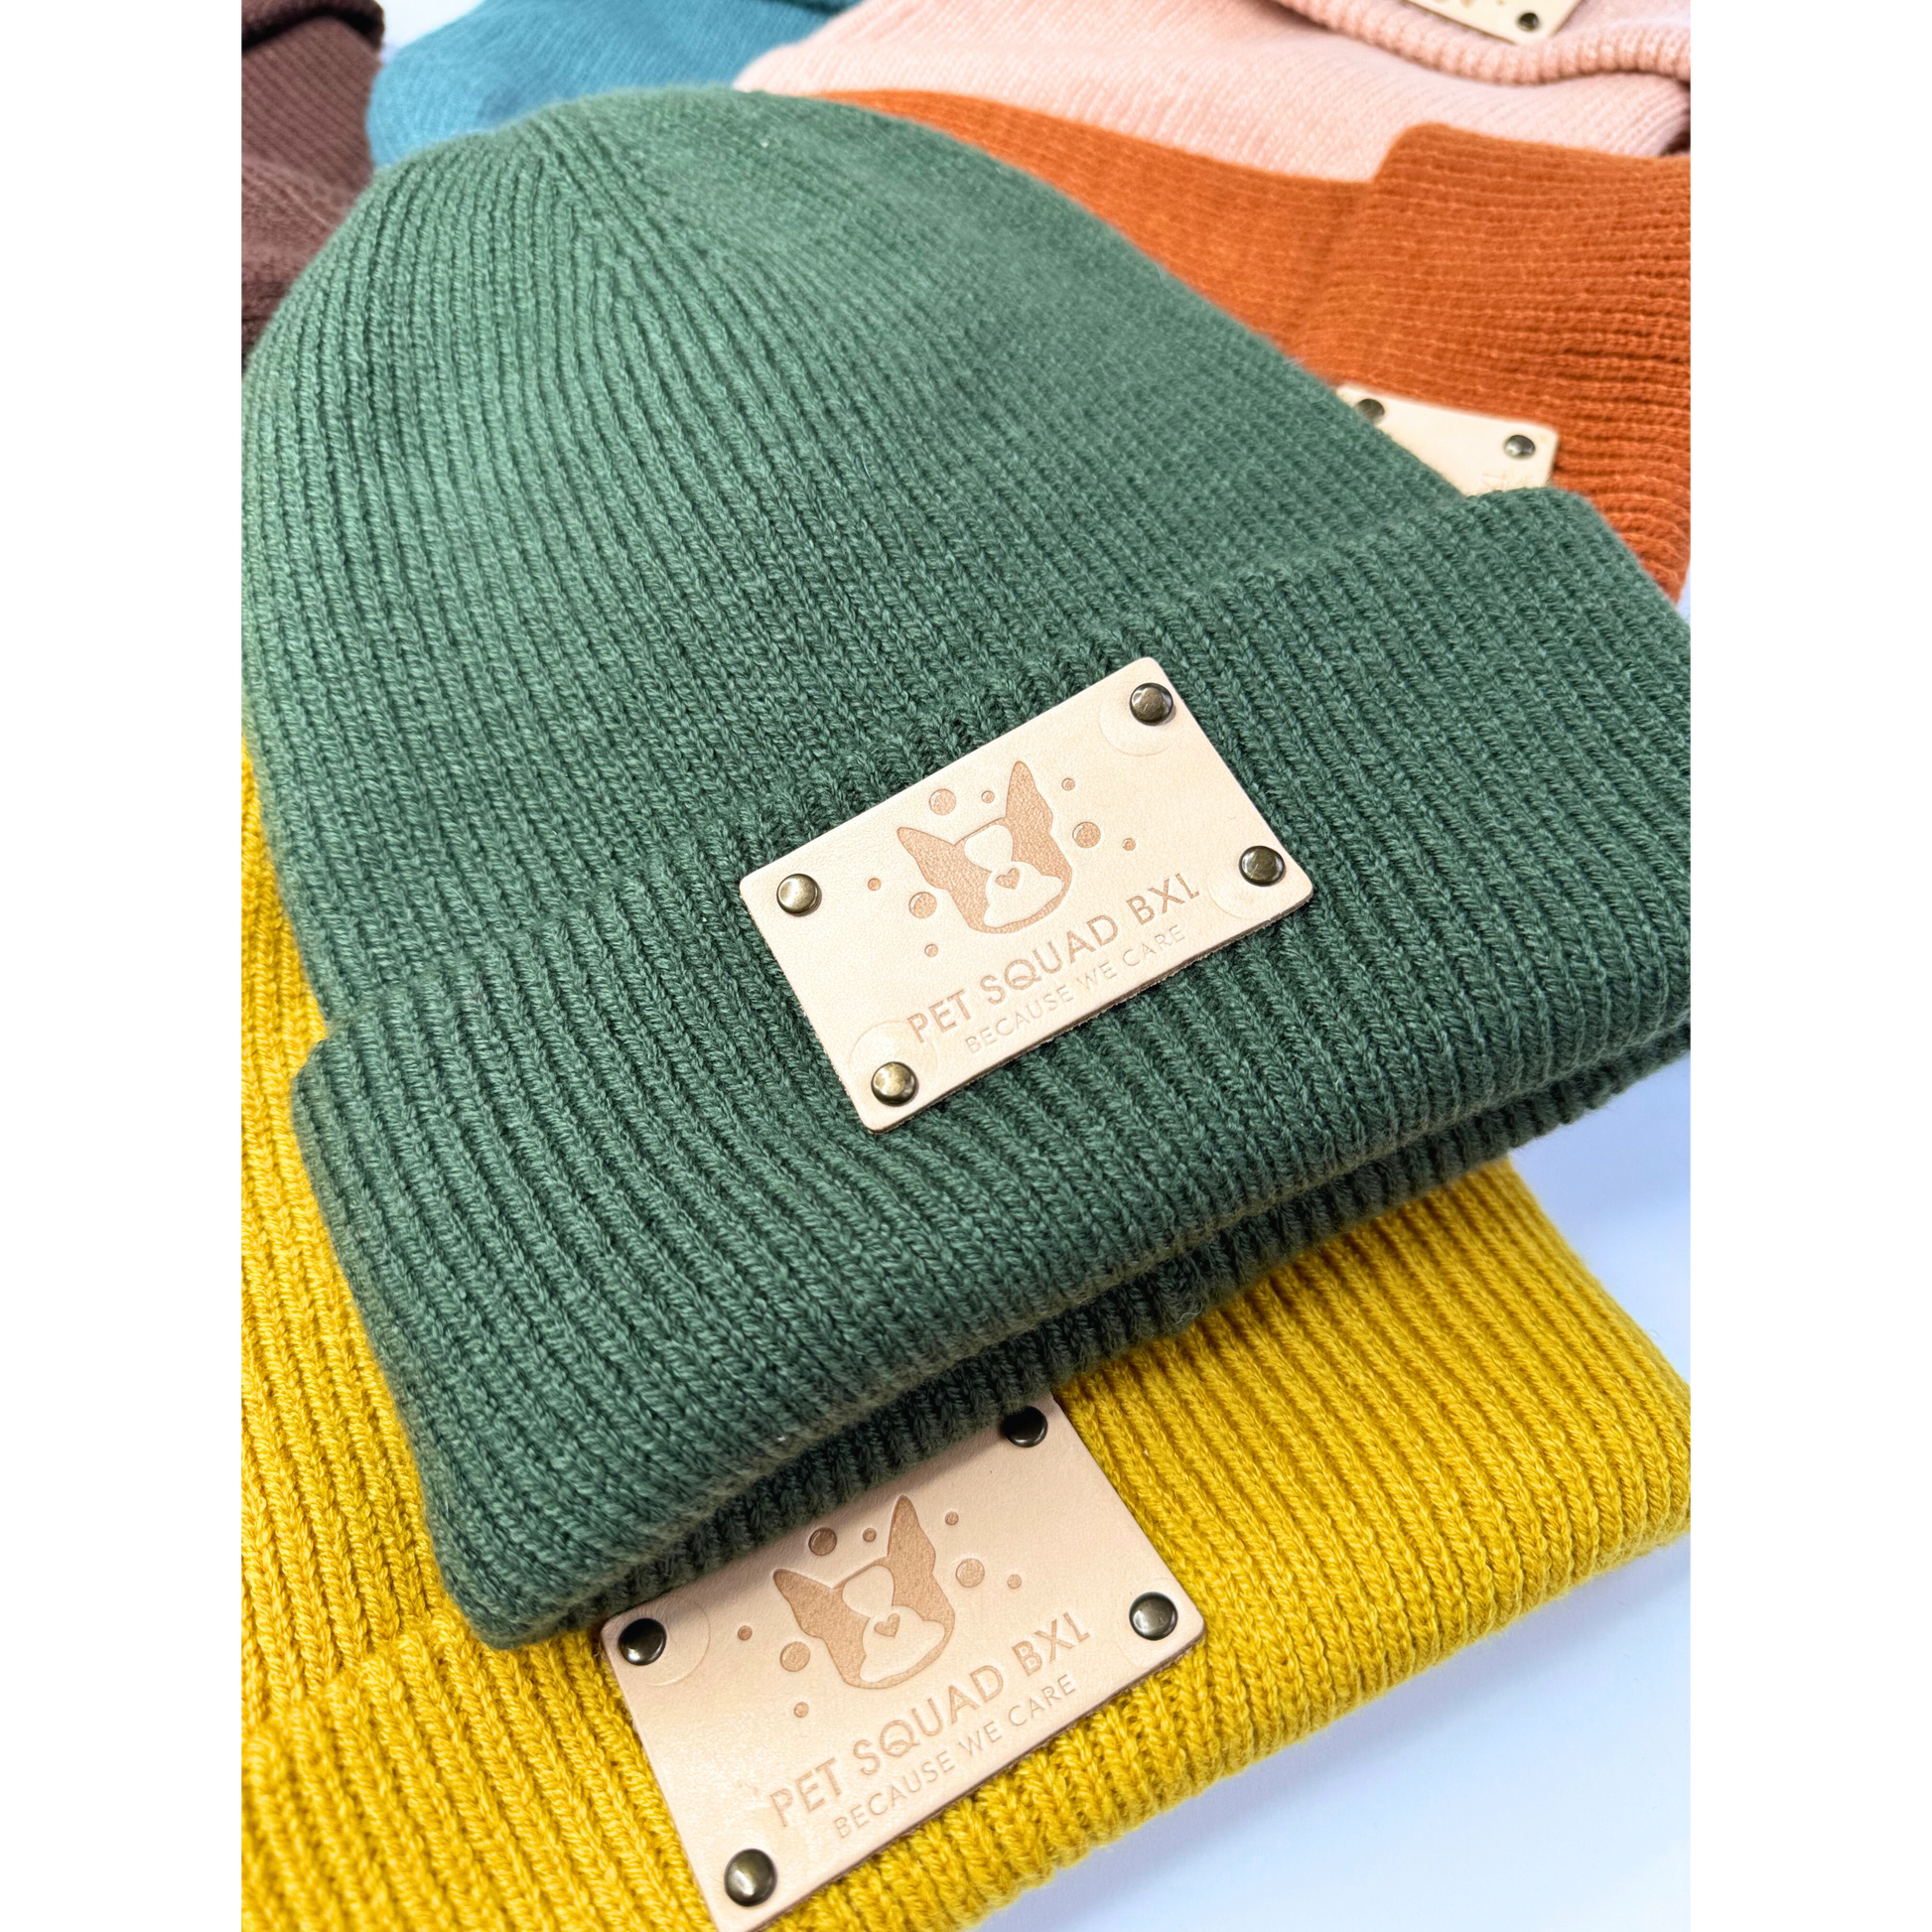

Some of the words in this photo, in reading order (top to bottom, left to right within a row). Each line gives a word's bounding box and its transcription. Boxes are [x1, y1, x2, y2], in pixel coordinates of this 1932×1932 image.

[907, 989, 971, 1043] PET
[980, 914, 1118, 1006] SQUAD
[1126, 873, 1200, 925] BXL
[965, 985, 1074, 1054] BECAUSE
[1077, 961, 1118, 991] WE
[1122, 924, 1185, 968] CARE
[769, 1757, 842, 1828] PET
[853, 1664, 1004, 1776] SQUAD
[1012, 1611, 1090, 1676] BXL
[834, 1749, 956, 1839] BECAUSE
[958, 1721, 1003, 1757] WE
[1008, 1674, 1076, 1726] CARE
